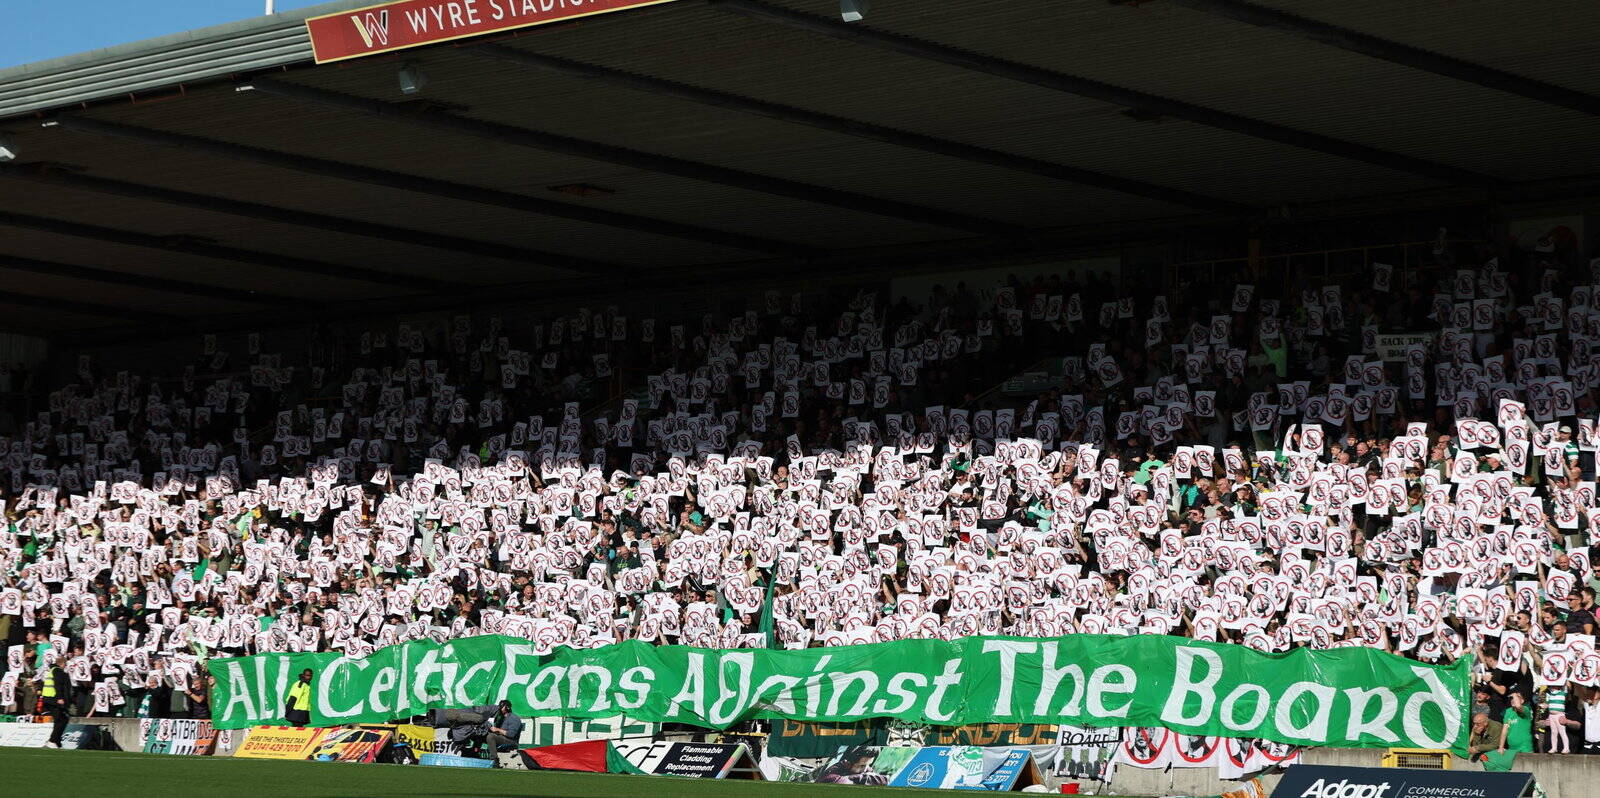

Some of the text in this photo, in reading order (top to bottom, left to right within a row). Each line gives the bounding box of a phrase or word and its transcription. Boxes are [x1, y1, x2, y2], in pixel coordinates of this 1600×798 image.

[406, 0, 595, 35] WYRE STAD
[222, 640, 1459, 749] All Celtic Fans Against The Board
[681, 746, 723, 754] Flammable
[679, 754, 713, 763] Cladding
[665, 763, 714, 771] Replacement
[1300, 778, 1392, 798] Adapt
[1408, 786, 1486, 797] COMMERCIAL
